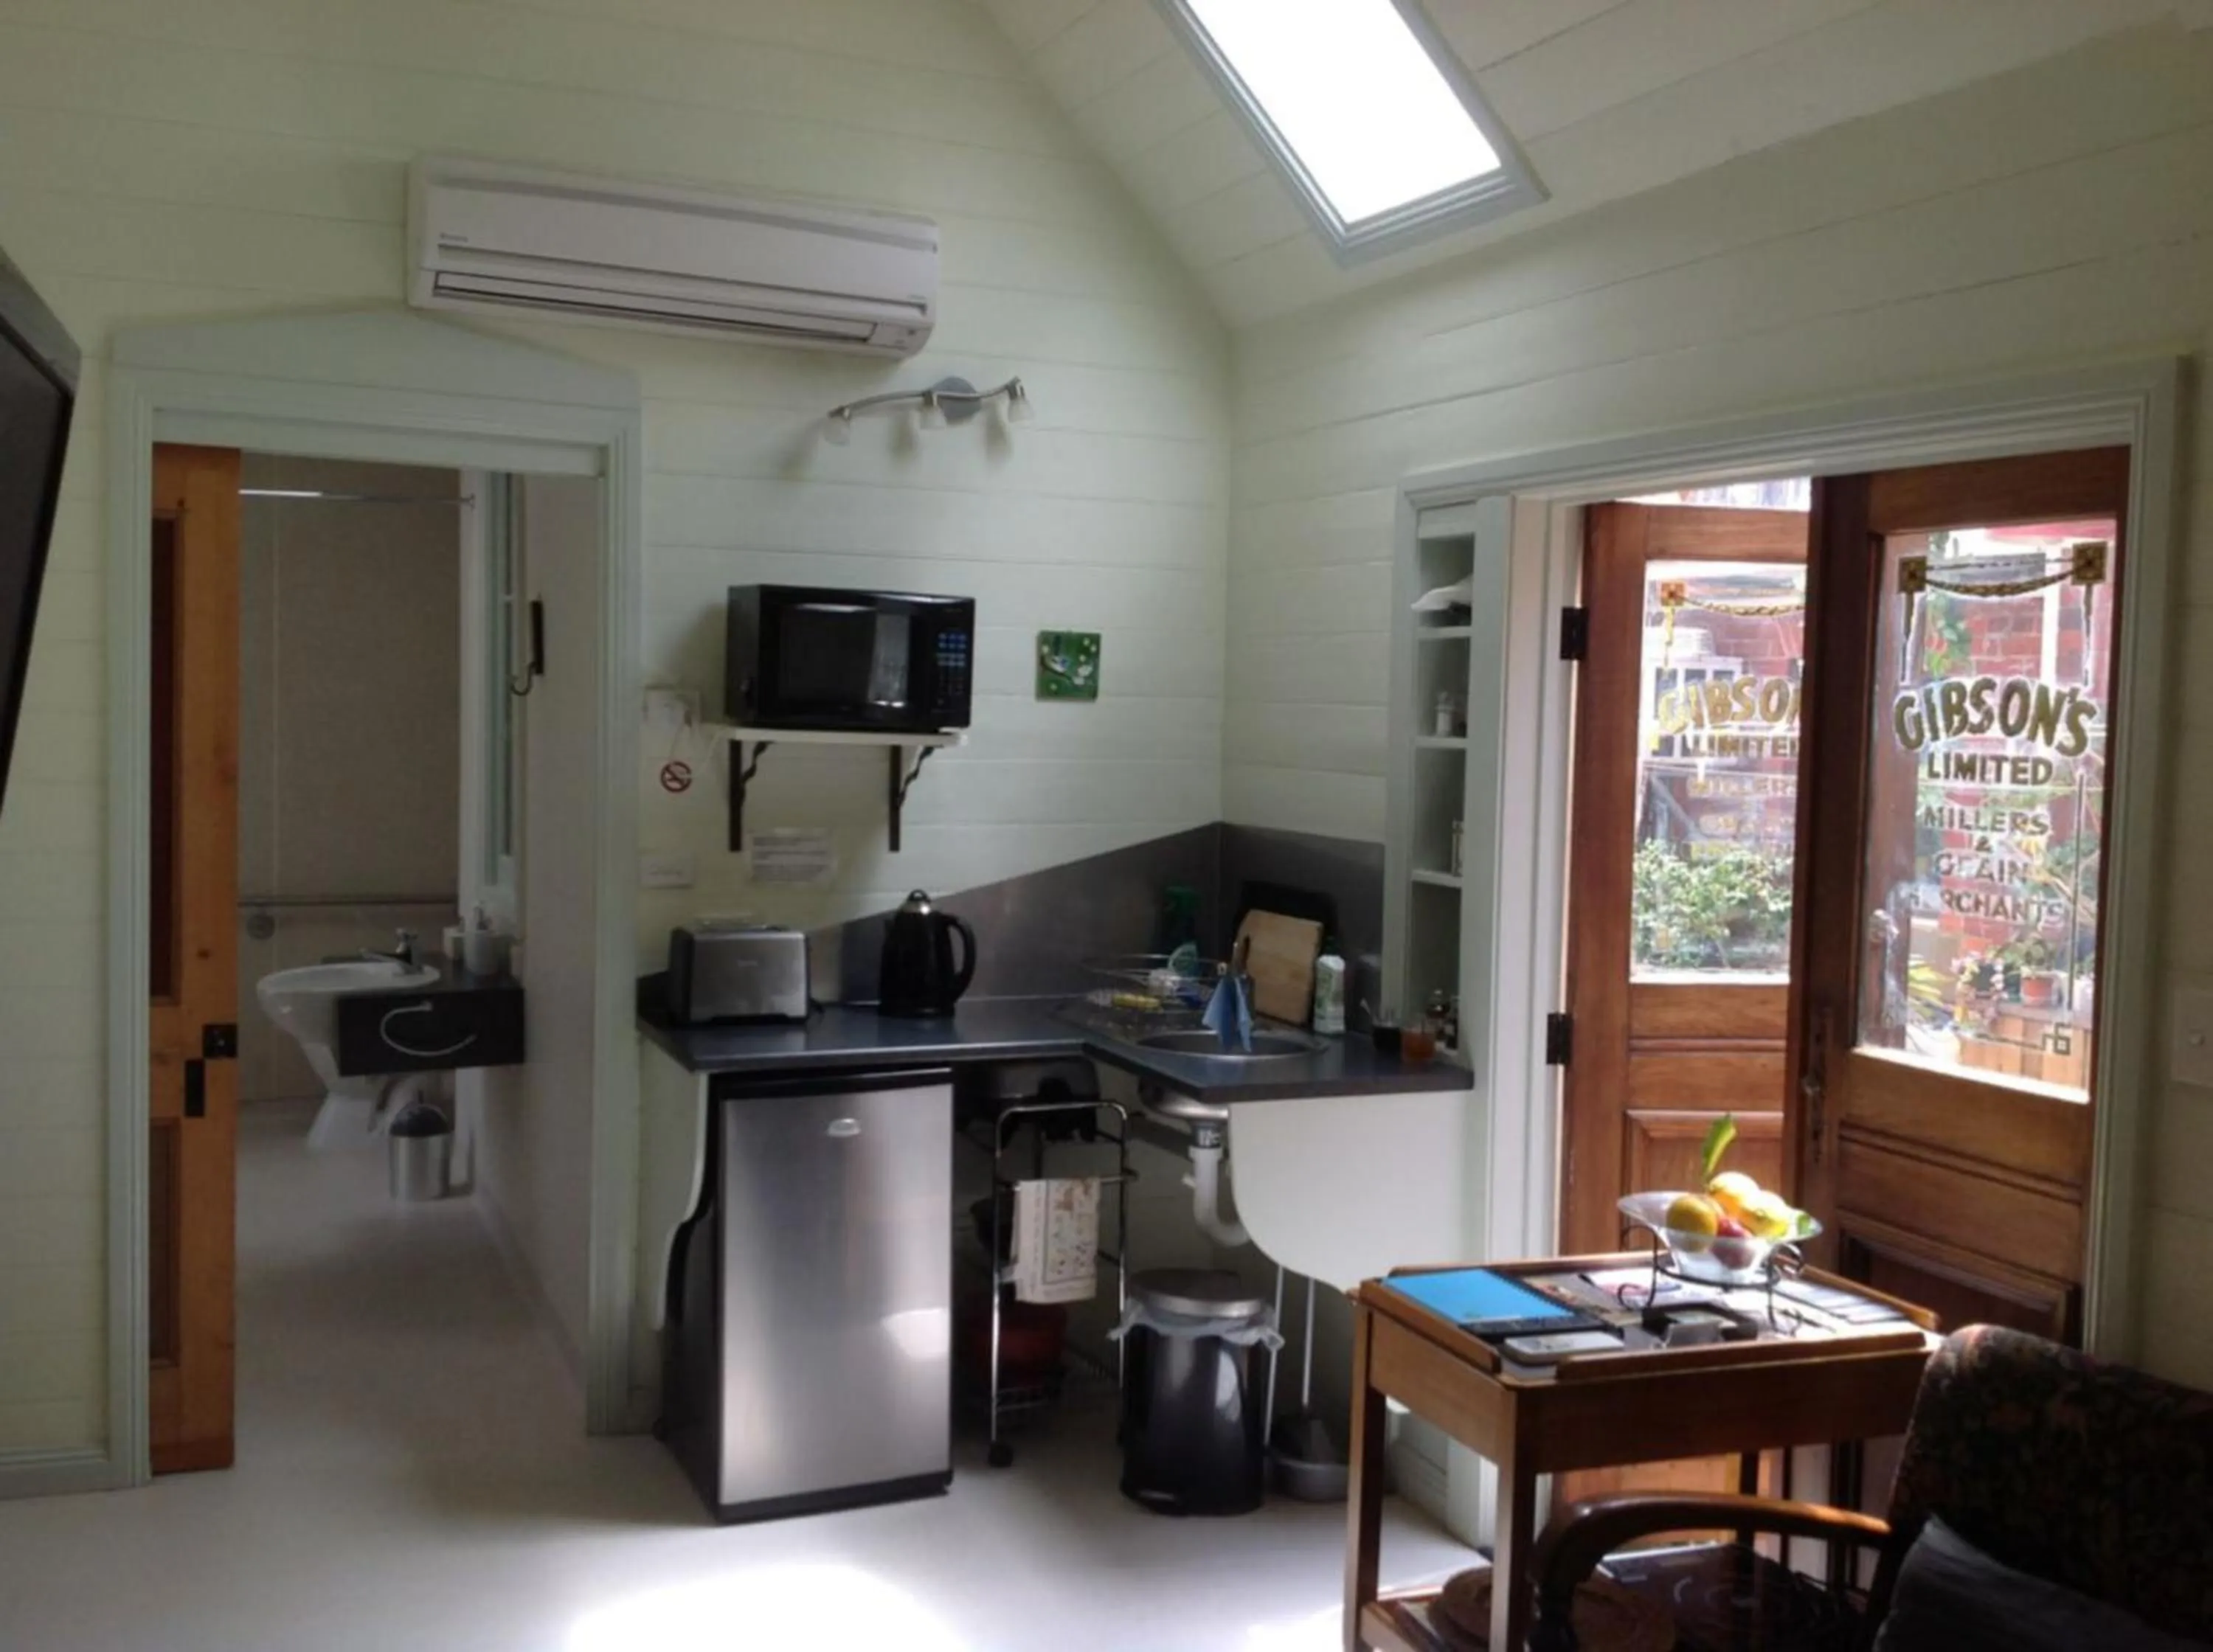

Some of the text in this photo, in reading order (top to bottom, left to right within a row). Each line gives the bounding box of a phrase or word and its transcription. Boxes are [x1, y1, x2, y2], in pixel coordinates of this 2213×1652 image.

[1894, 676, 2097, 757] GIBSON'S
[1927, 751, 2054, 786] LIMITED
[1924, 805, 2049, 836] MILLERS
